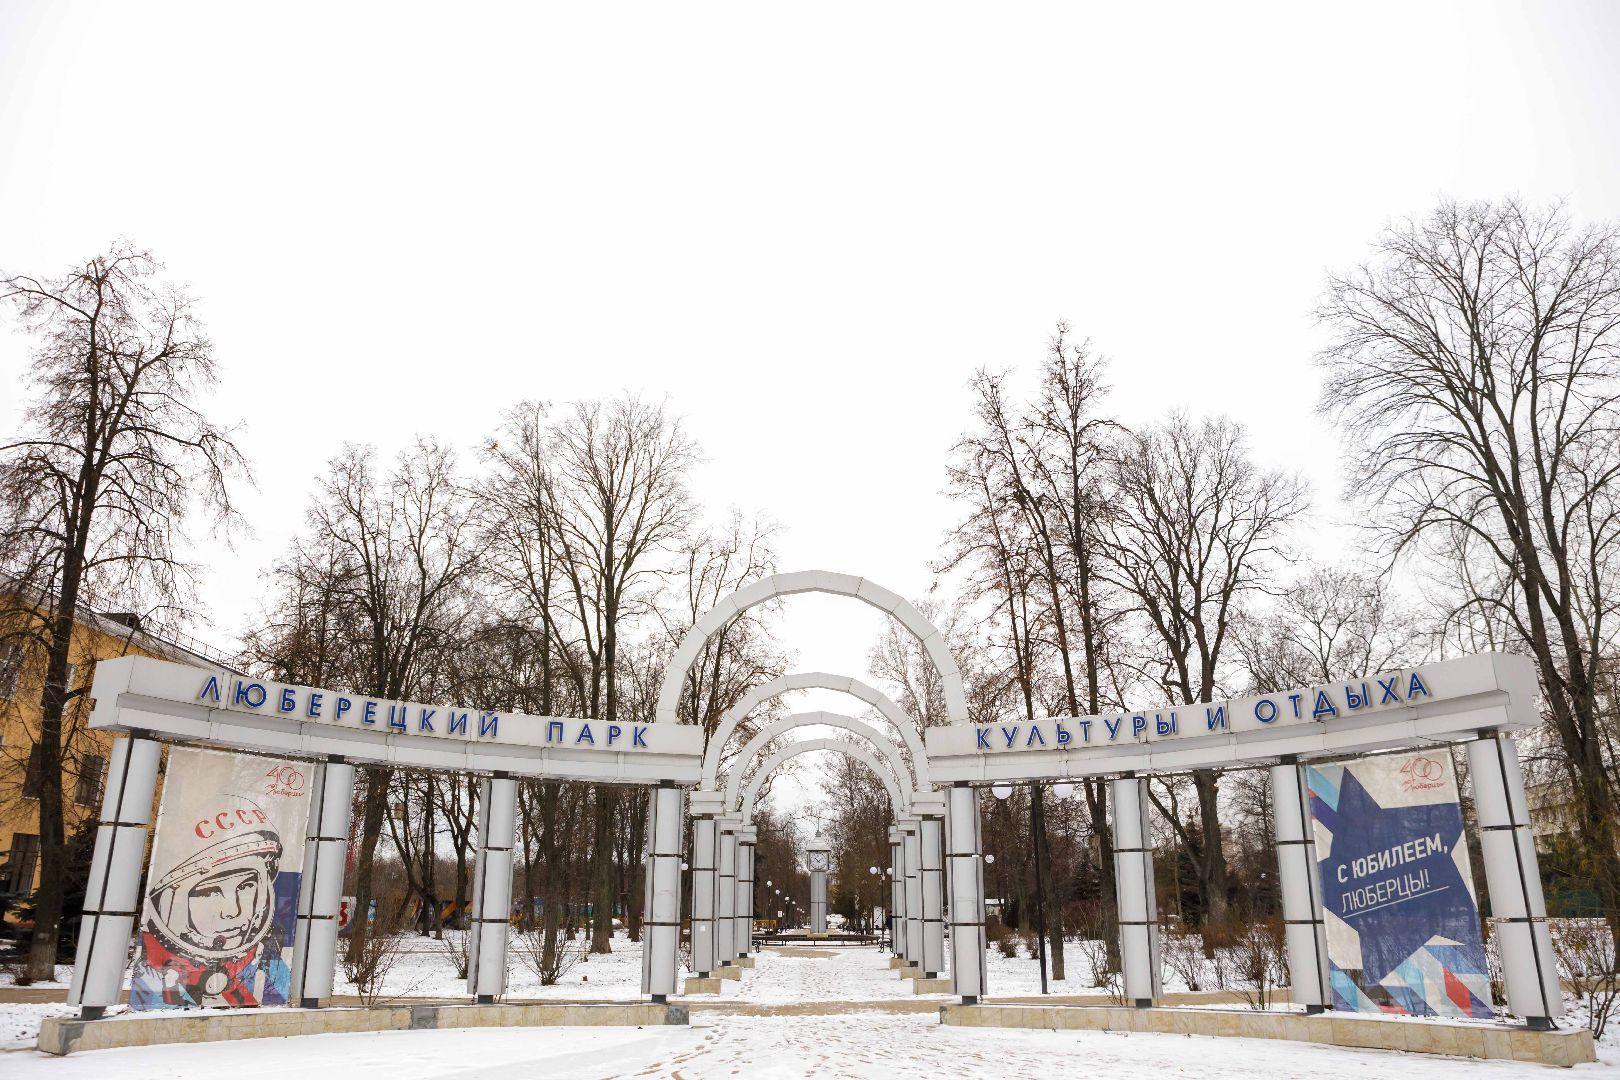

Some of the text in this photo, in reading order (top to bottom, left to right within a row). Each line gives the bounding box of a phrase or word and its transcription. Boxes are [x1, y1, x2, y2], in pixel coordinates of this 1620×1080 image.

[201, 676, 648, 747] ЛЮБЕРЕЦКИЙ ПАРК
[976, 672, 1428, 749] КУЛЬТУРЫ И ОТДЫХА
[266, 766, 304, 790] 400
[1400, 757, 1443, 781] 400
[195, 809, 266, 838] СССР
[1337, 833, 1448, 884] С ЮБИЛЕЕМ,
[1342, 868, 1430, 914] ЛЮБЕРЦЫ!
